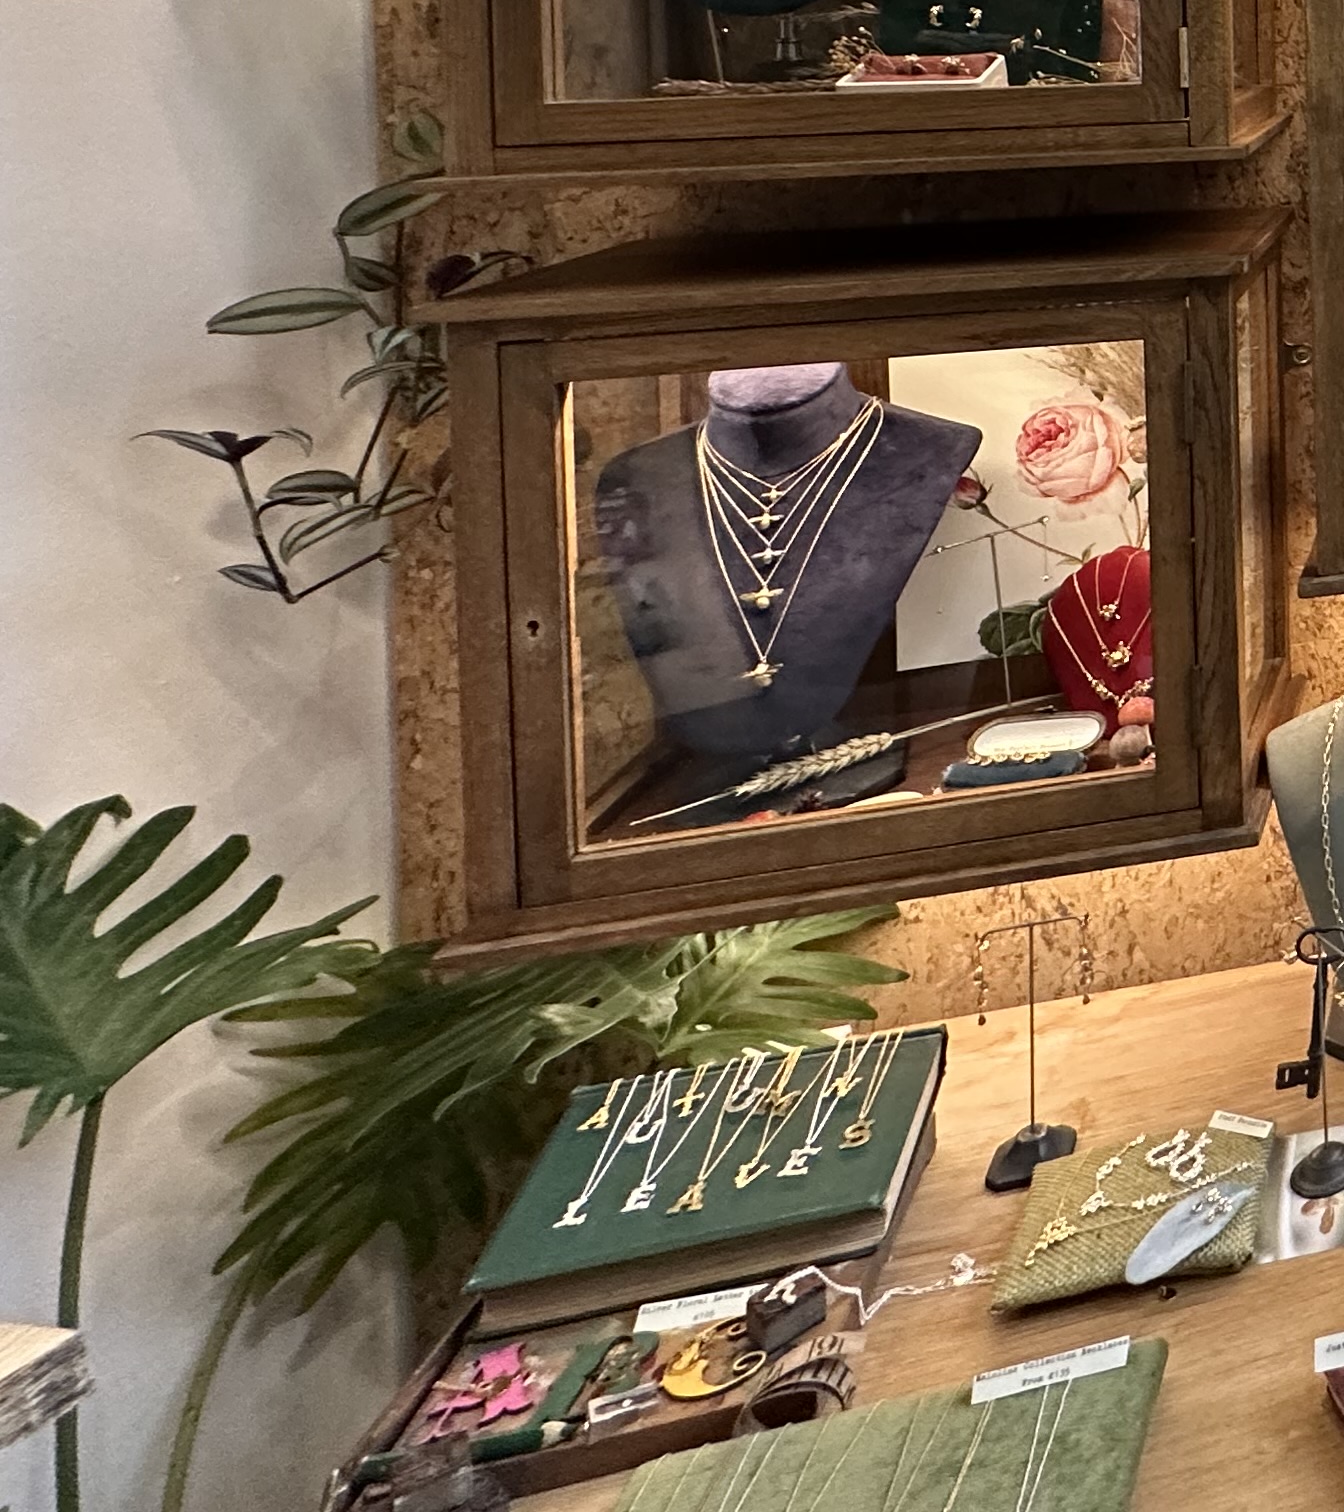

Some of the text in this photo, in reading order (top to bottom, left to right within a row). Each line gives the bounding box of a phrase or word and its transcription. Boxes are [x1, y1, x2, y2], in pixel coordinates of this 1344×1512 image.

[676, 1296, 708, 1308] Floral
[1022, 1351, 1078, 1371] Collection
[1081, 1338, 1129, 1356] Necklaces
[1022, 1375, 1044, 1387] From
